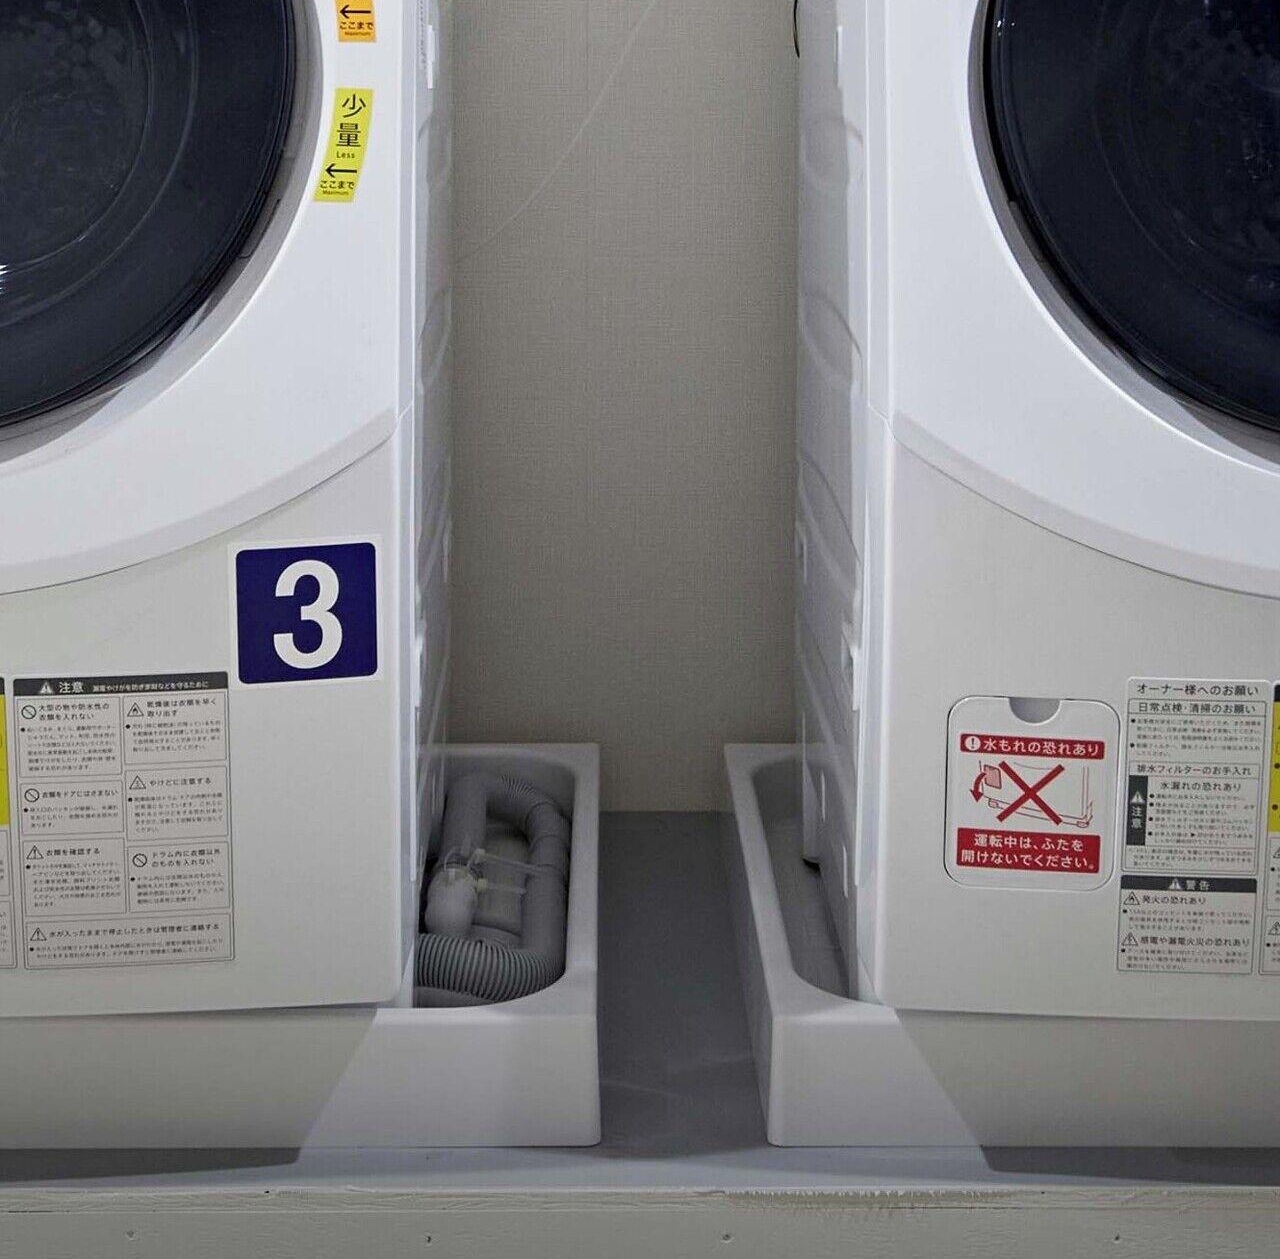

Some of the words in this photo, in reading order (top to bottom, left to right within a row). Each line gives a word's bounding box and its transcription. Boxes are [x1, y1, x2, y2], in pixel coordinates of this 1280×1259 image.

[339, 21, 374, 31] ここまで
[335, 93, 367, 148] 少量
[336, 151, 356, 159] Less
[320, 180, 355, 190] ここまで
[273, 559, 343, 670] 3
[58, 681, 85, 694] 注意
[1136, 683, 1259, 696] オーナー様へのお願い
[983, 737, 1099, 757] 水もれの恐れあり
[1136, 763, 1252, 775] 排水フィルターのお手入れ
[1160, 781, 1242, 792] 水漏れの恐れあり
[973, 833, 1084, 852] 運転中は、ふたを
[960, 848, 1095, 870] 開けないでください。
